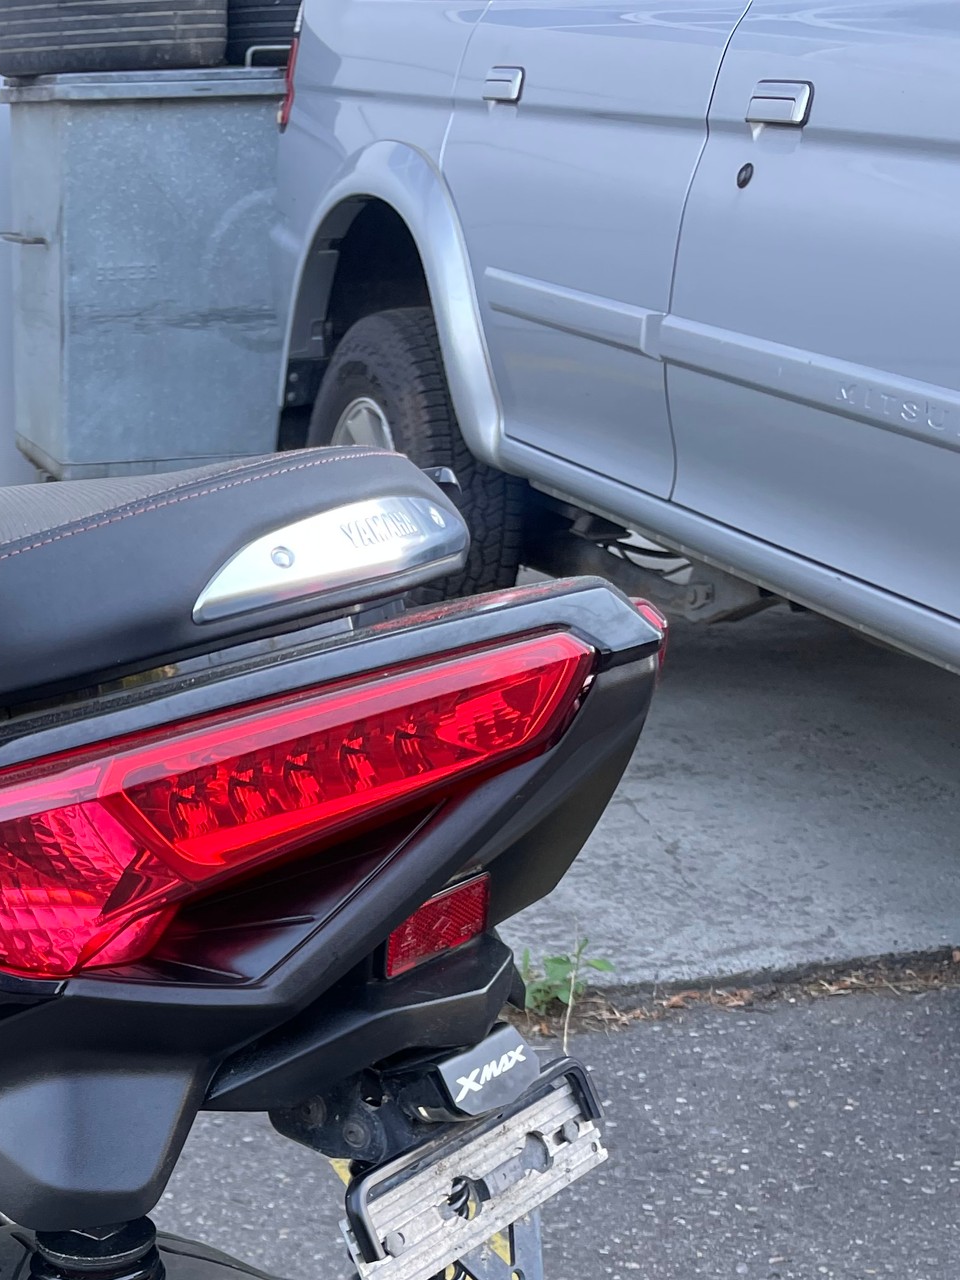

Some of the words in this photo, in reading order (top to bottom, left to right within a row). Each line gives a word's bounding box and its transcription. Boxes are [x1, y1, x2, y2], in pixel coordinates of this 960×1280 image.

[835, 381, 960, 436] MITSU
[340, 510, 418, 549] YAMAHA
[454, 1044, 527, 1103] XMAX
